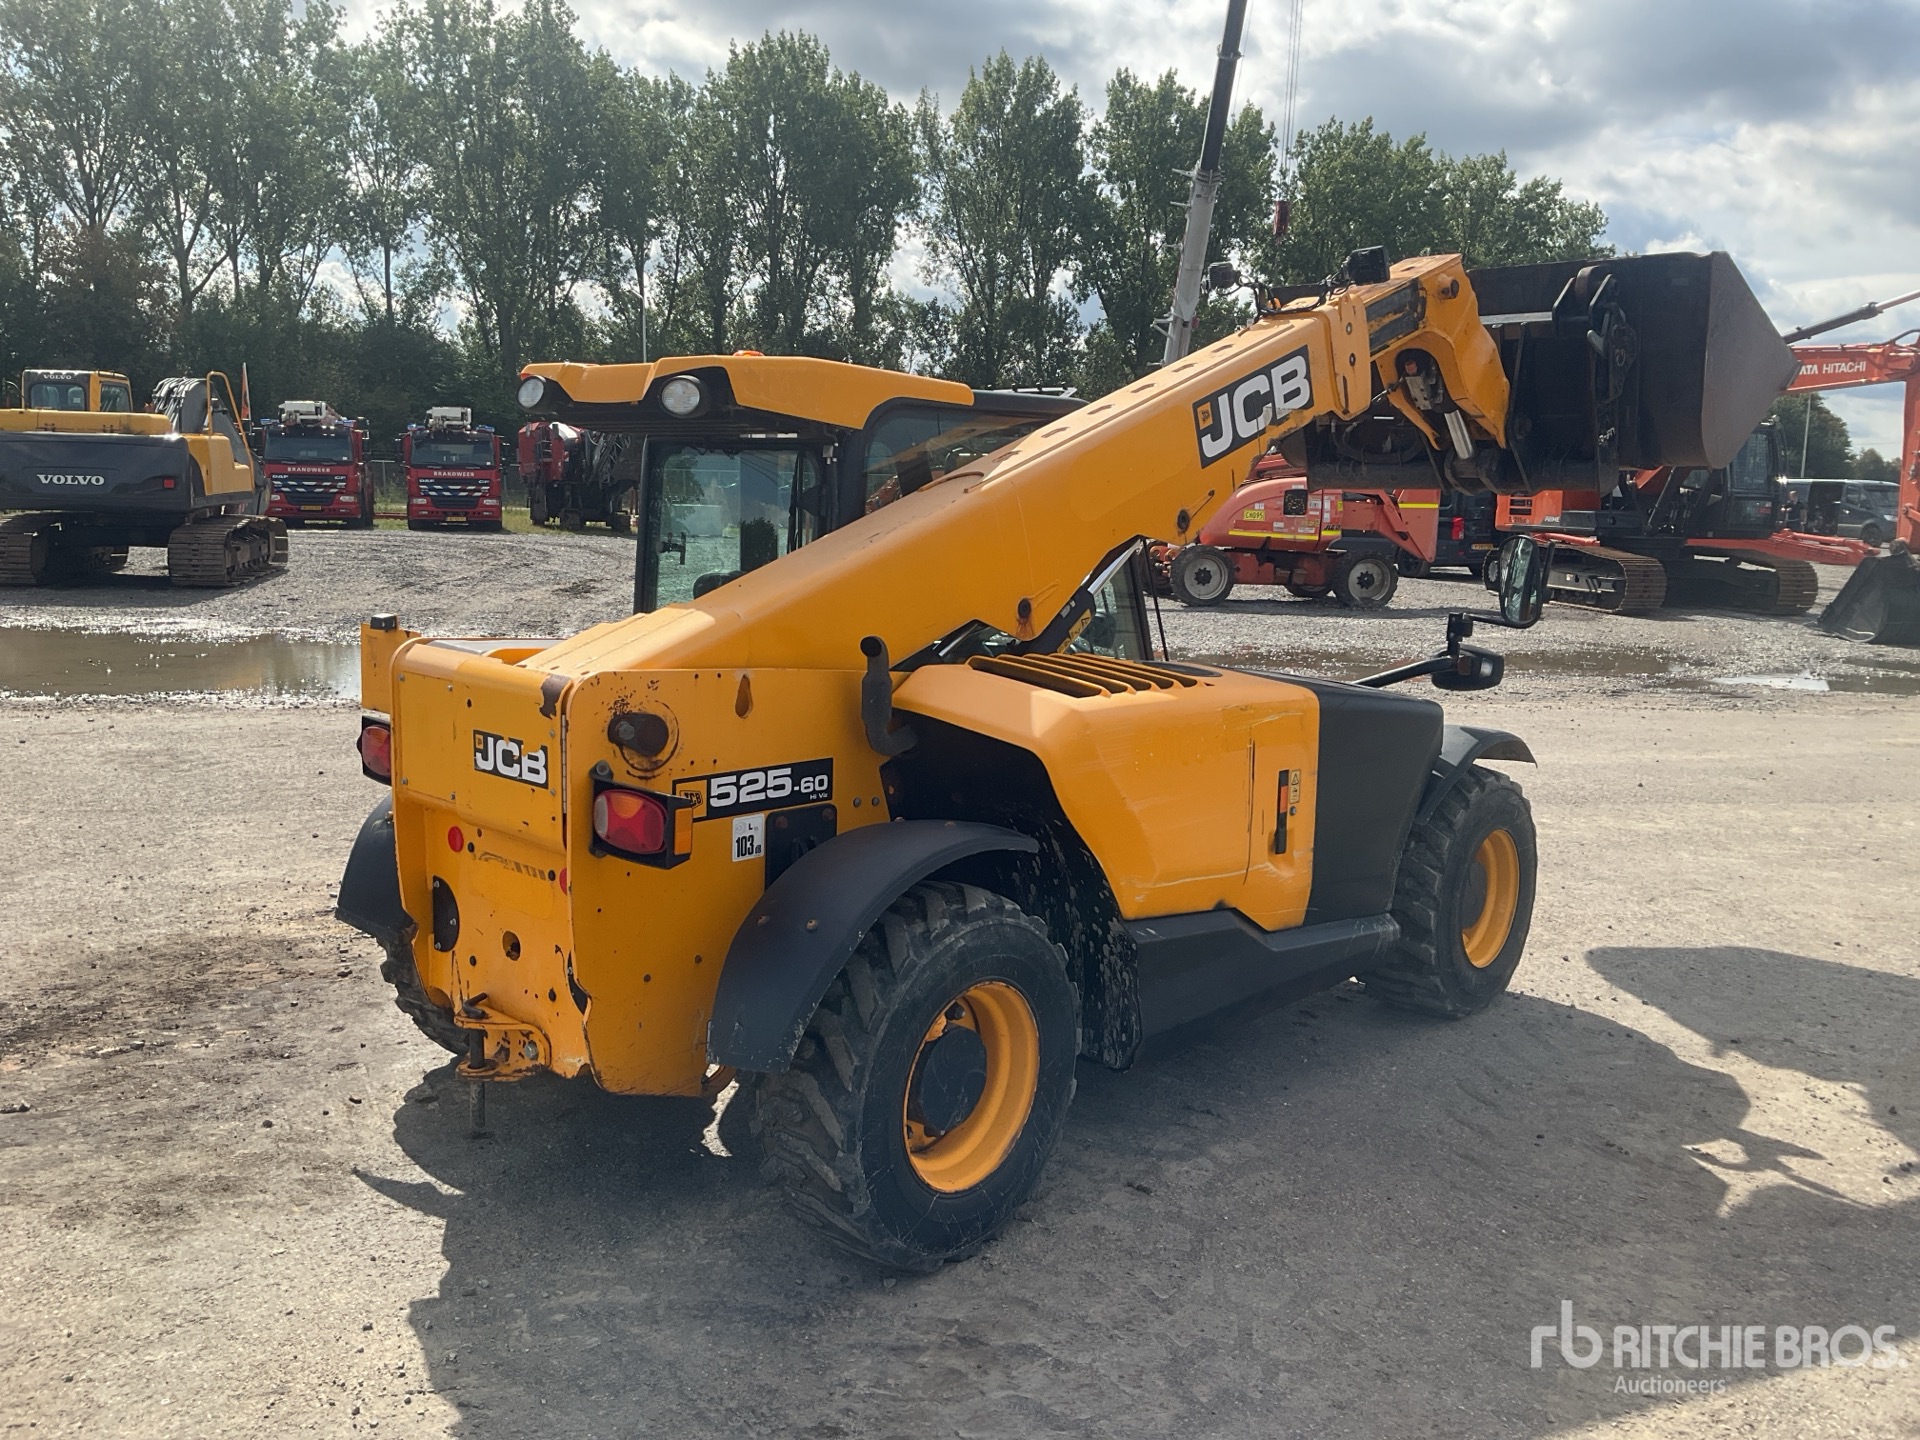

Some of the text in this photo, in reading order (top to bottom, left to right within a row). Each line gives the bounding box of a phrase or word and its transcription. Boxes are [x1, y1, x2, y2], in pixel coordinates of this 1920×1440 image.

[1799, 361, 1867, 375] ATA HITACHI
[1201, 355, 1310, 458] JCB
[37, 474, 105, 486] VOLVO
[475, 736, 547, 784] JCB
[735, 834, 762, 858] 103 dB
